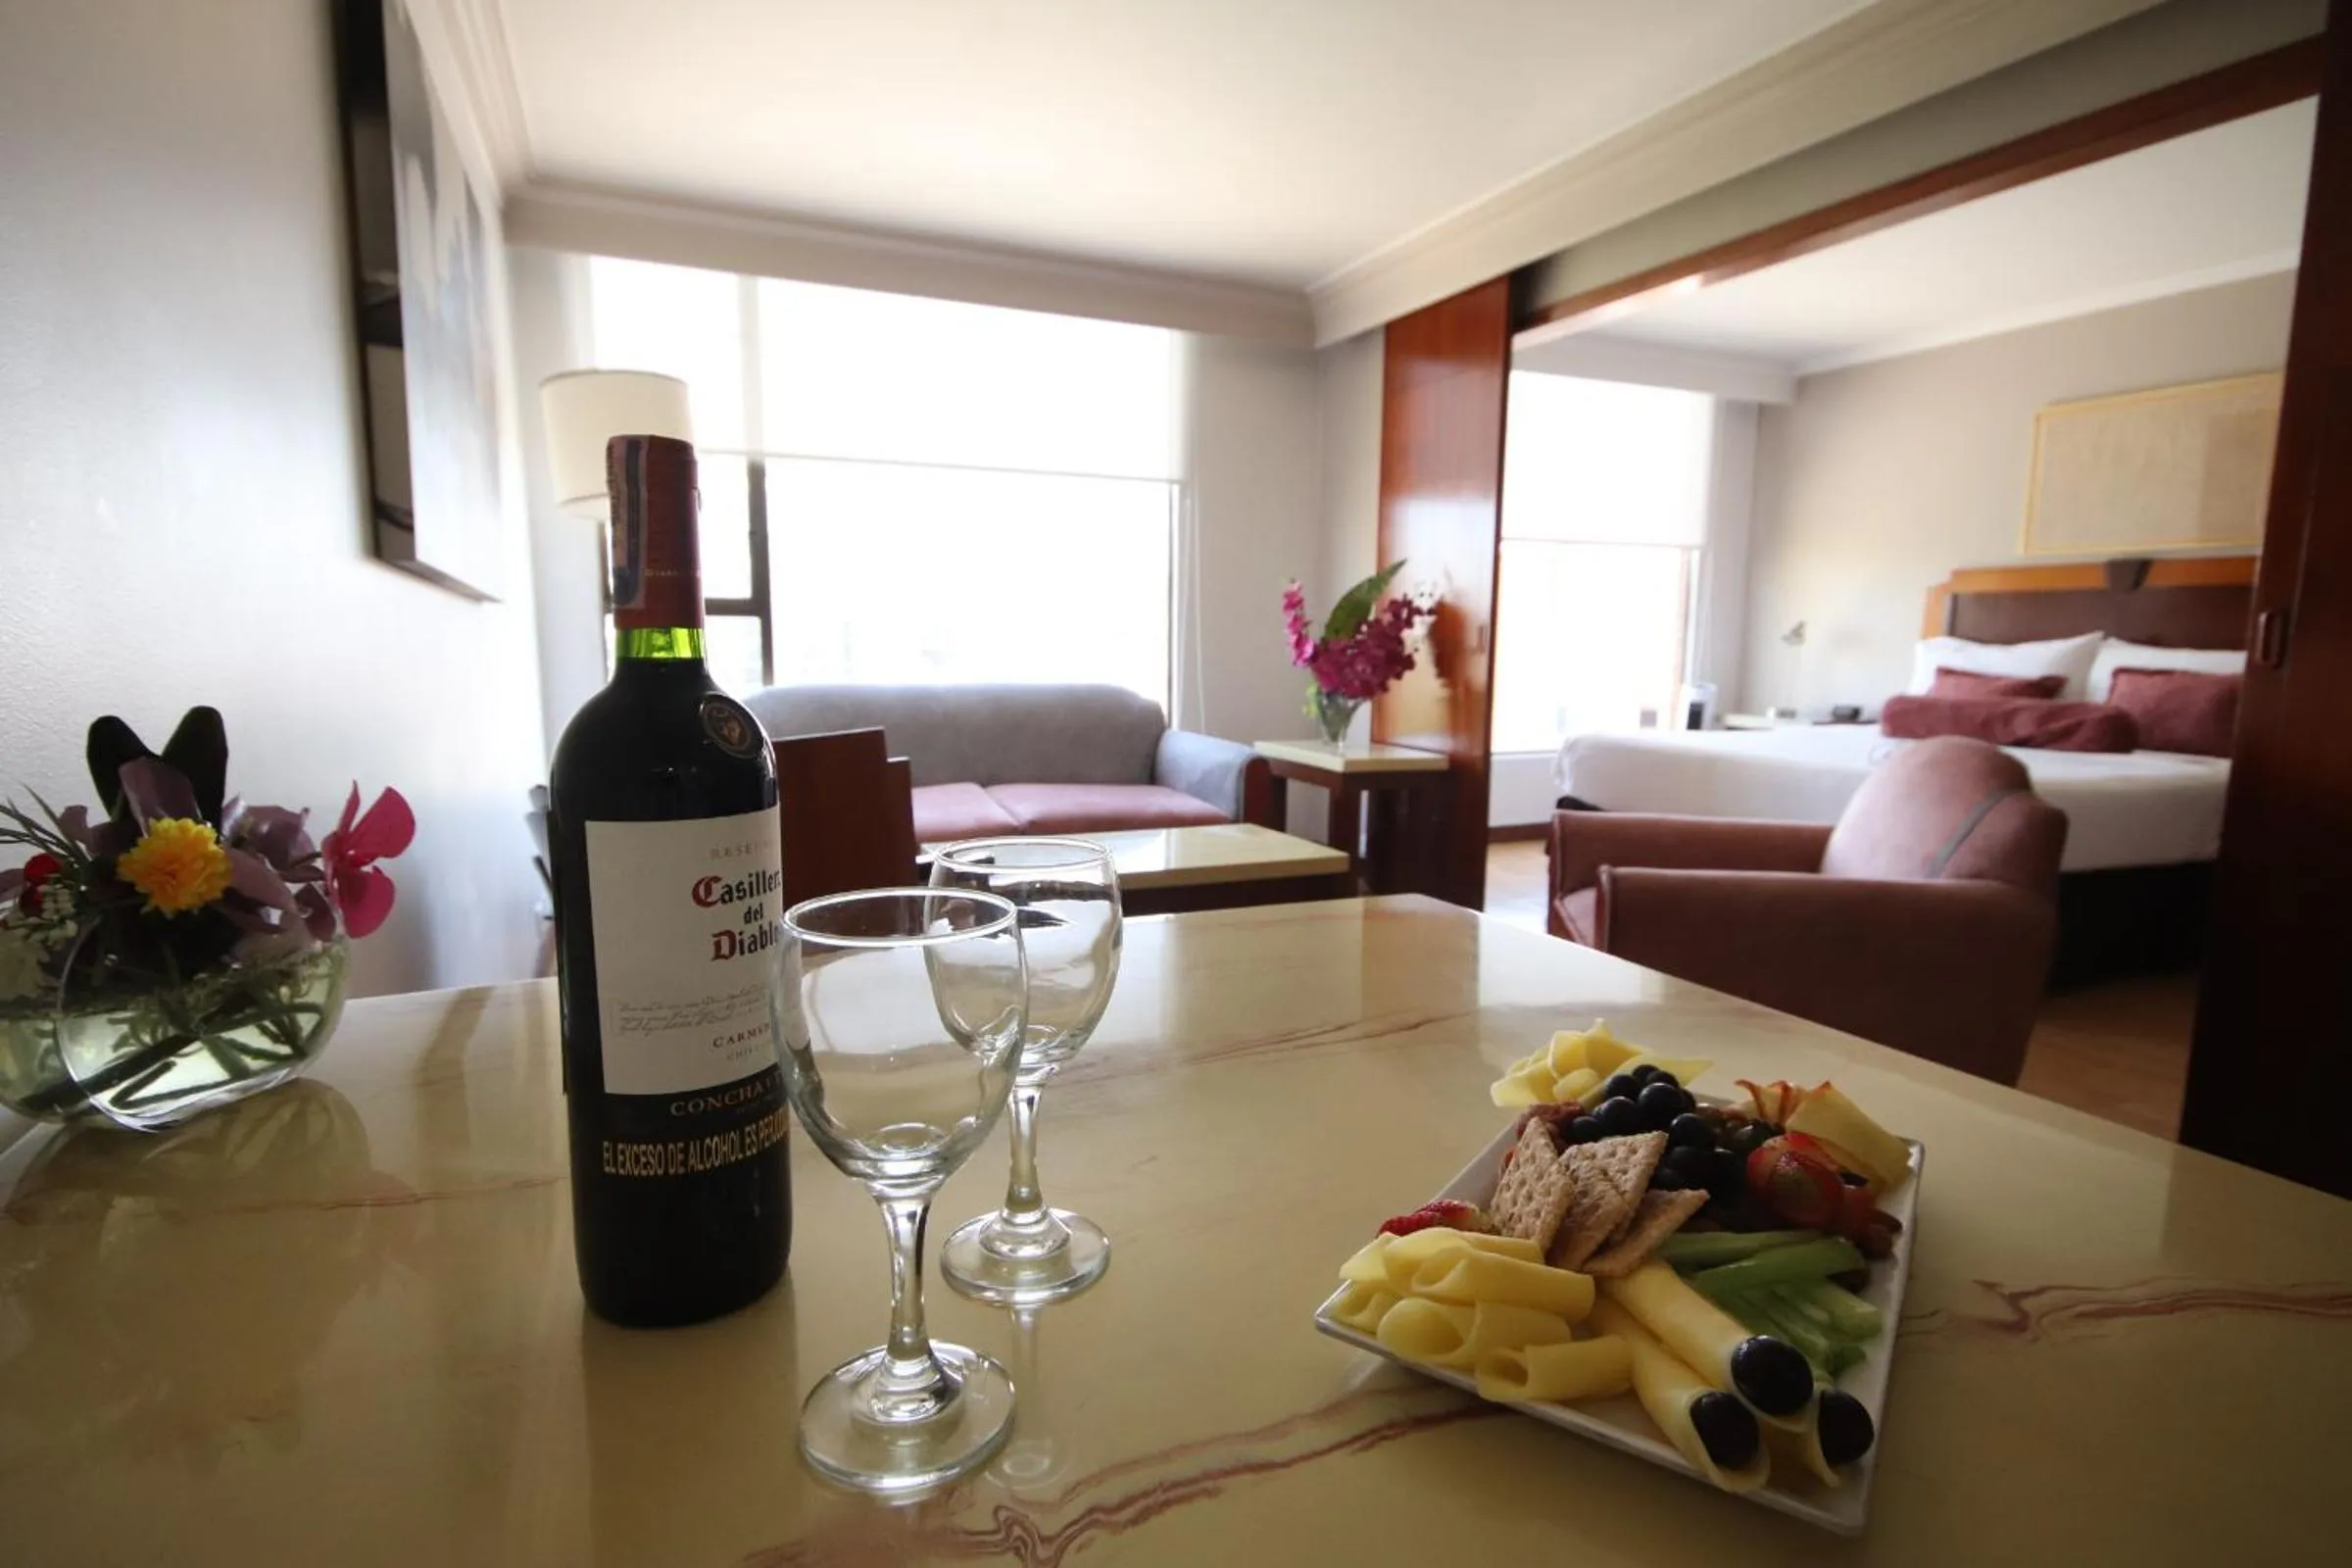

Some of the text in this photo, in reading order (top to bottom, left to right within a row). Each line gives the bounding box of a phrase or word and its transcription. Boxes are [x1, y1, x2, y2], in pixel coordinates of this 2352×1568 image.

[744, 902, 763, 925] del
[670, 1079, 764, 1116] CONCHA
[603, 1141, 616, 1174] EL
[617, 1143, 665, 1176] EXCESO
[667, 1142, 686, 1175] DE
[688, 1129, 744, 1173] ALCOHOL
[745, 1123, 758, 1156] ES
